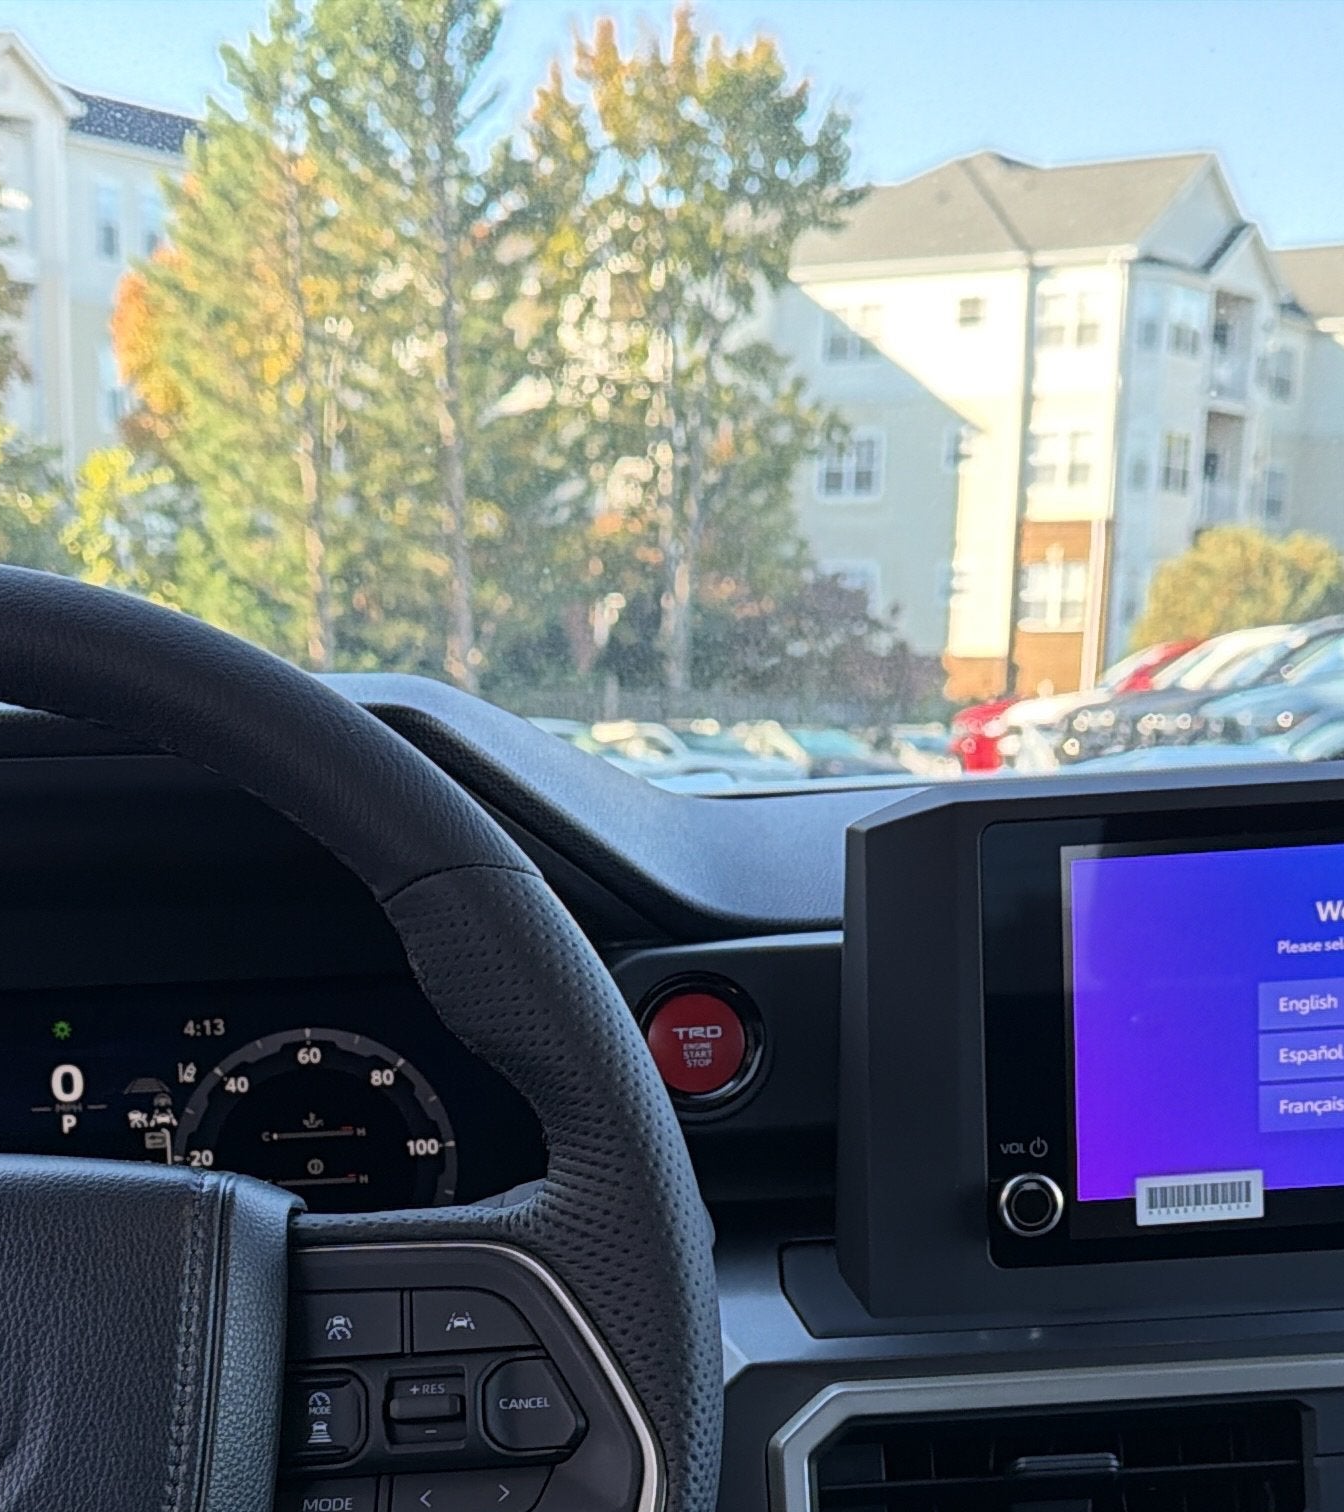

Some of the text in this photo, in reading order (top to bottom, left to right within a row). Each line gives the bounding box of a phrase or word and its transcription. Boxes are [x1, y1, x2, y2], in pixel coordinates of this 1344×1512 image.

[1276, 939, 1322, 955] Please
[1278, 994, 1338, 1016] English
[183, 1018, 226, 1037] 4:13
[672, 1025, 723, 1041] TRD
[297, 1047, 321, 1065] 60
[1279, 1043, 1344, 1066] Español
[50, 1063, 84, 1102] 0
[224, 1076, 249, 1094] 40
[370, 1068, 395, 1087] 80
[62, 1114, 77, 1134] P
[406, 1138, 440, 1156] 100
[1000, 1142, 1026, 1155] VOL
[190, 1149, 214, 1166] 20
[308, 1405, 333, 1416] MODE
[499, 1396, 551, 1411] CANCEL
[302, 1496, 353, 1512] MODE
